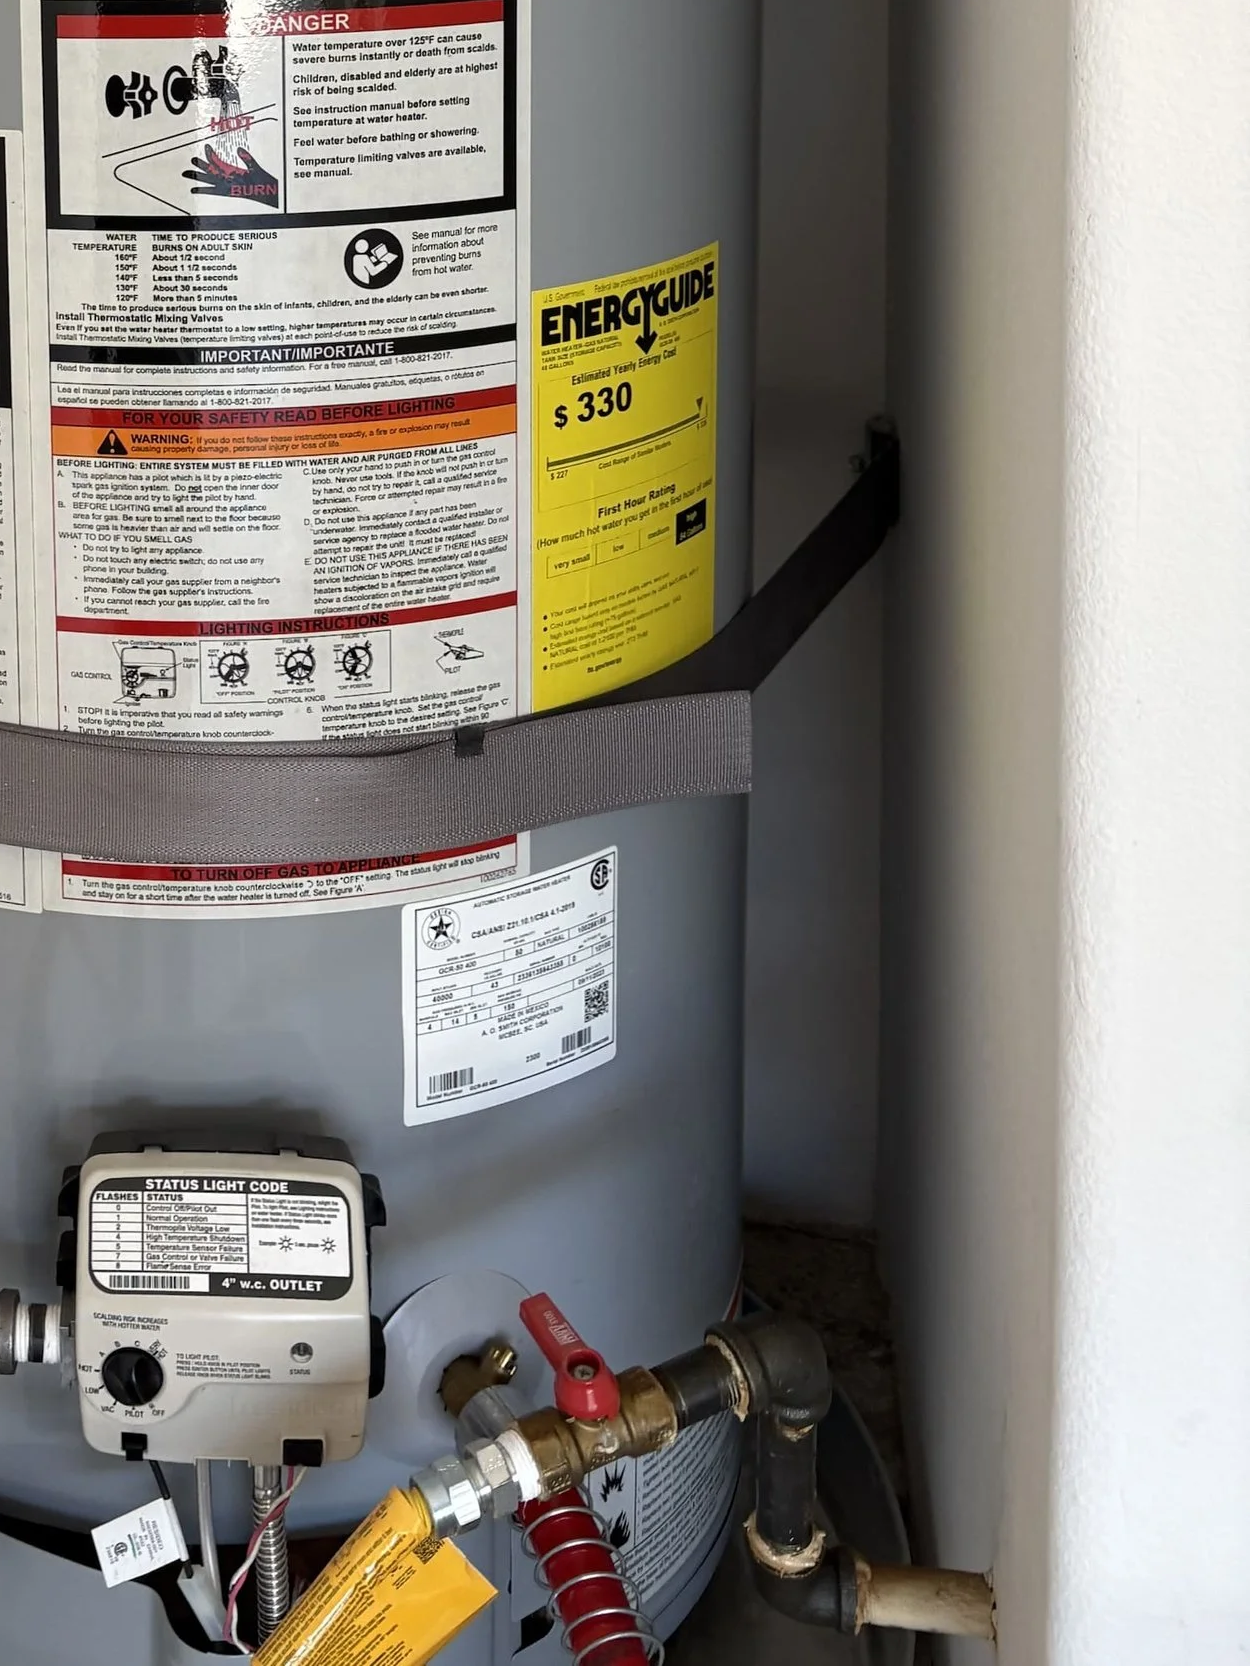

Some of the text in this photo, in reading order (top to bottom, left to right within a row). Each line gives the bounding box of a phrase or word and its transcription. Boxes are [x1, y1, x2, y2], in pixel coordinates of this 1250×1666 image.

[292, 42, 321, 52] Water
[324, 39, 382, 52] temperature
[385, 39, 406, 47] over
[437, 35, 453, 44] can
[456, 33, 482, 42] cause
[292, 43, 498, 64] severe burns instantly or death from scalds.
[230, 184, 277, 196] BURN
[152, 234, 173, 242] TIME
[191, 233, 235, 241] PRODUCE
[238, 232, 278, 240] SERIOUS
[72, 243, 137, 252] TEMPERATURE
[152, 244, 183, 252] BURNS
[200, 243, 230, 251] ADULT
[232, 243, 253, 251] SKIN
[541, 261, 714, 351] ENERGYGUIDE
[56, 312, 223, 325] Install Thermostatic Mixing Valves
[200, 341, 395, 363] IMPORTANT/IMPORTANTE
[571, 366, 611, 386] Estimated
[614, 360, 636, 376] Yearly
[639, 352, 661, 368] Energy
[663, 346, 677, 360] Cost
[122, 397, 455, 424] FOR YOUR SAFETY READ BEFORE LIGHTING
[554, 382, 632, 430] $ 330
[131, 434, 193, 444] WARNING:
[551, 470, 568, 480] $ 227
[598, 483, 676, 519] First Hour Rating
[613, 543, 624, 552] low
[554, 554, 590, 570] very small
[201, 613, 389, 635] LIGHTING INSTRUCTIONS
[267, 695, 325, 705] CONTROL KNOB
[172, 854, 421, 881] TO TURN OFF GAS TO APPLIANCE
[537, 935, 565, 948] NATURAL
[498, 1015, 516, 1023] MADE
[526, 1002, 549, 1014] MEXICO
[145, 1179, 289, 1193] STATUS LIGHT CODE
[95, 1193, 183, 1202] FLASHES STATUS
[239, 1279, 266, 1290] w.c.
[270, 1279, 322, 1292] OUTLET
[78, 1364, 93, 1372] HOT
[125, 1409, 144, 1418] PILOT
